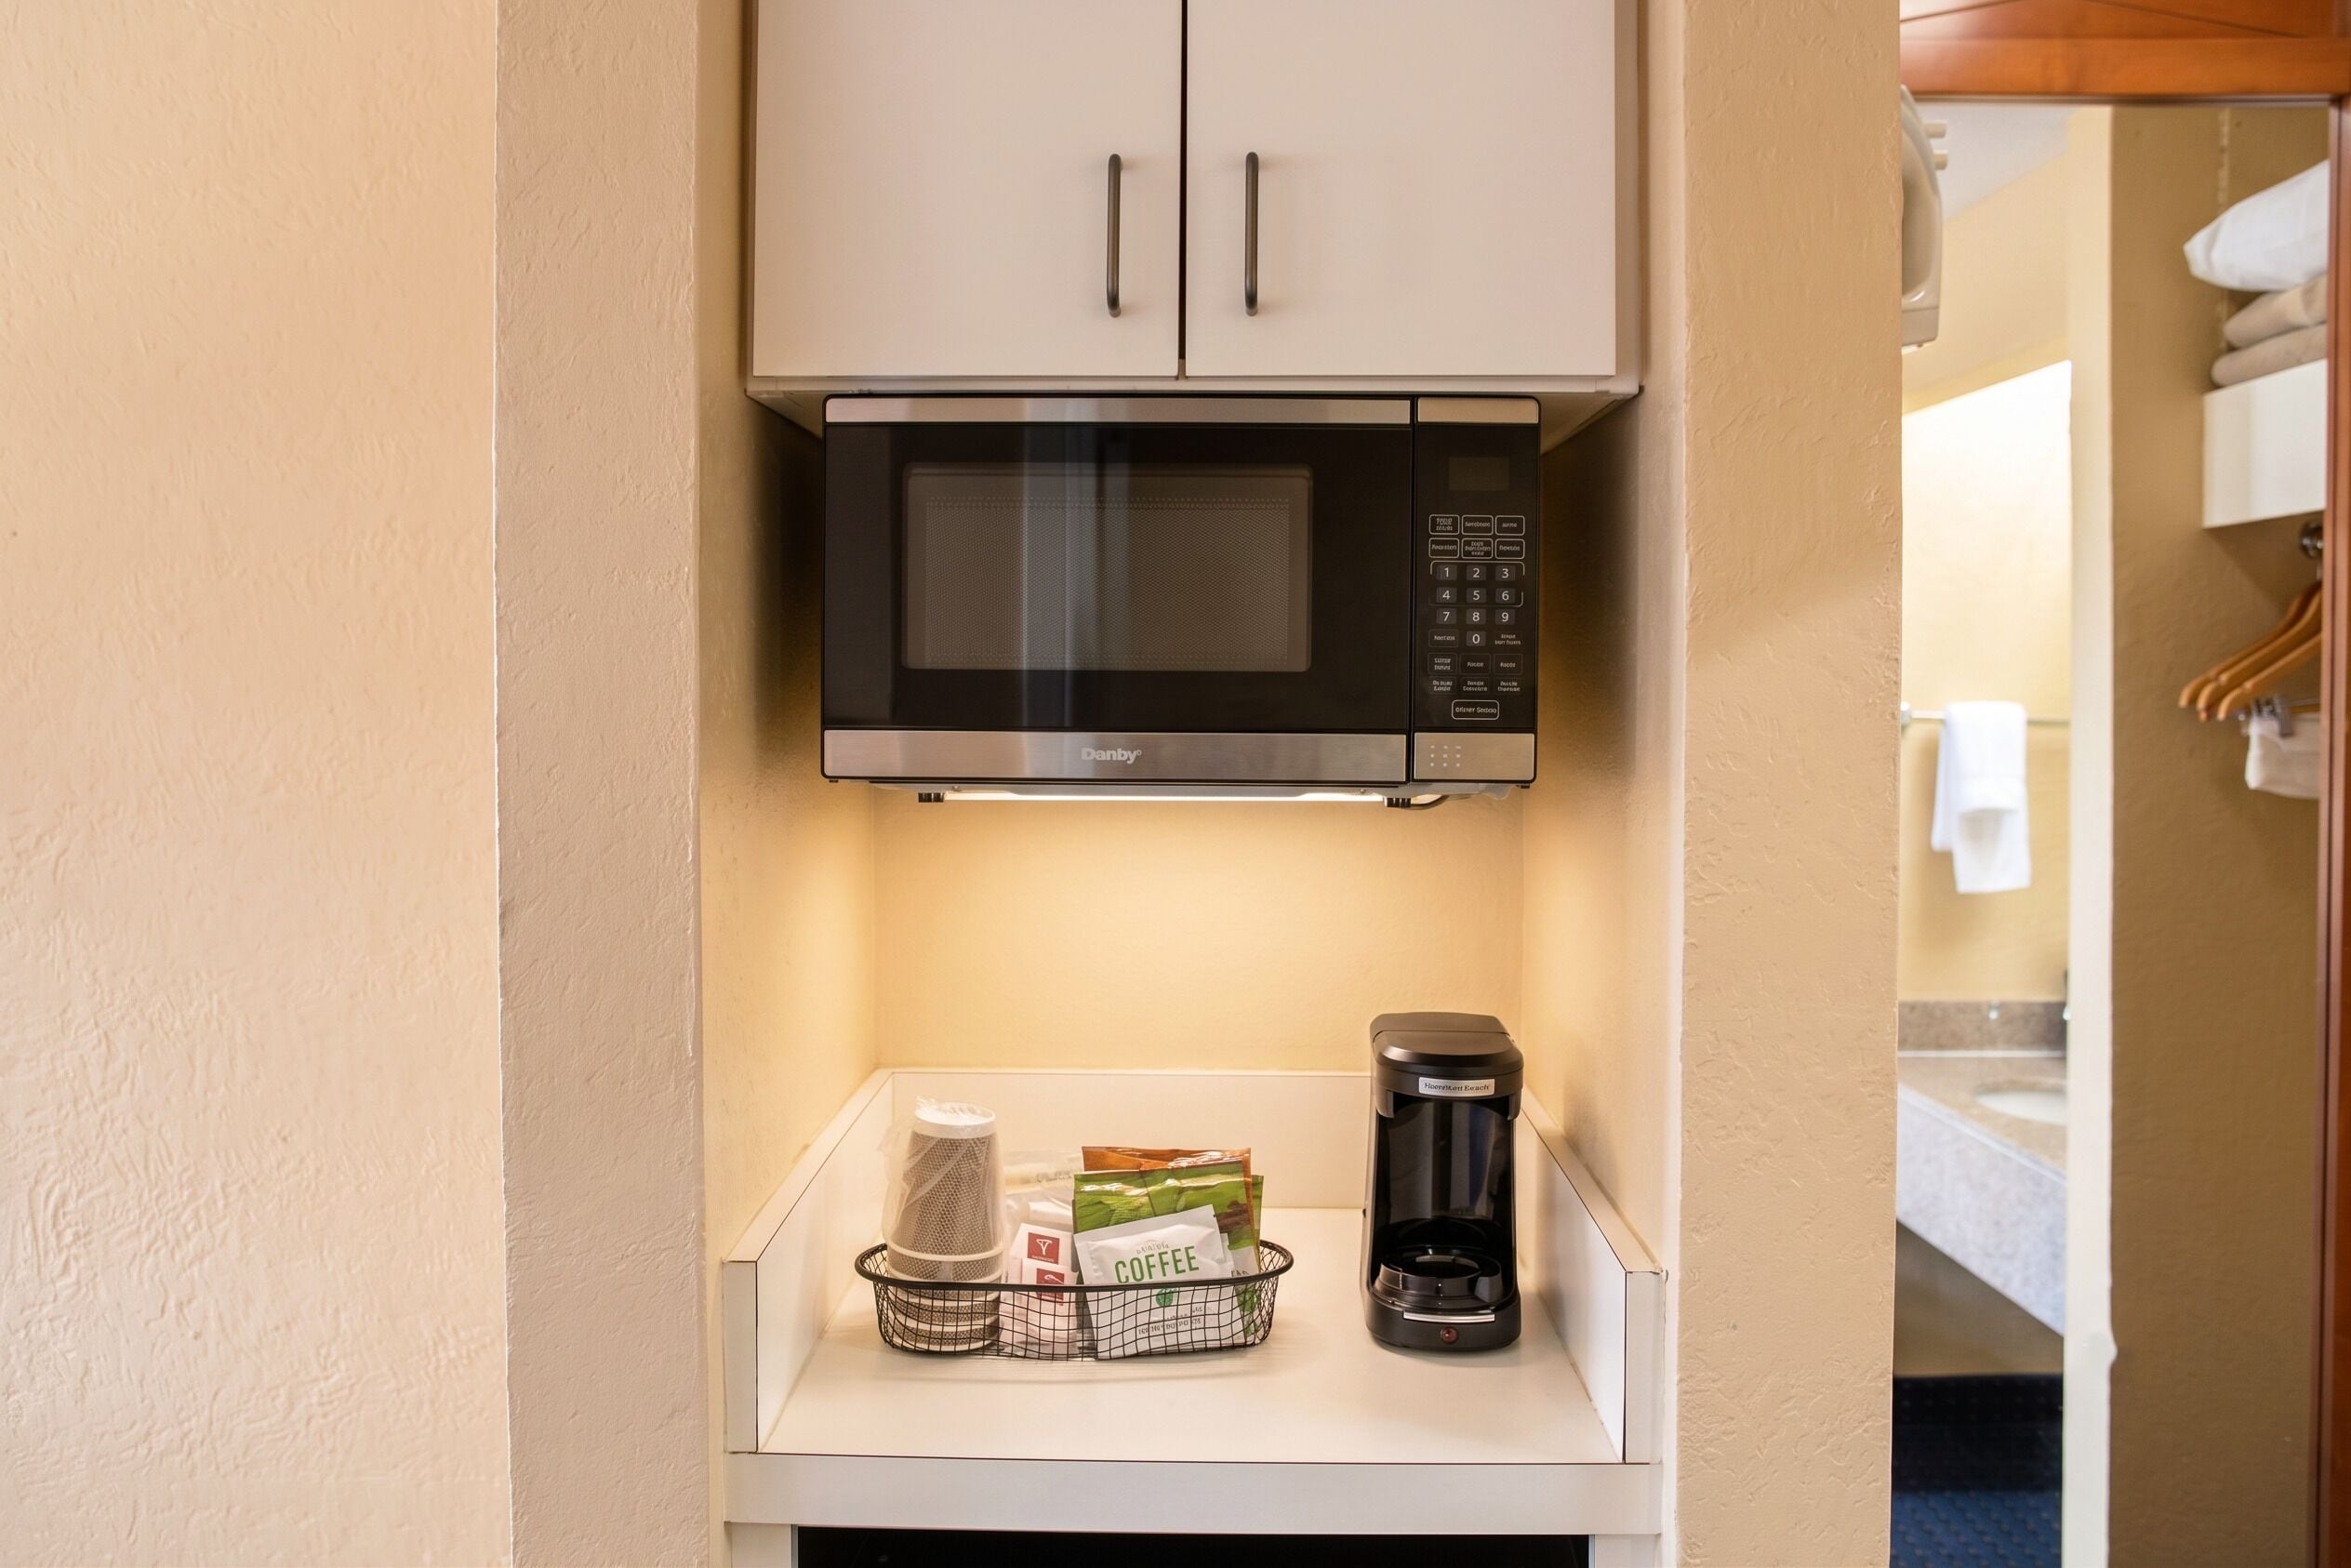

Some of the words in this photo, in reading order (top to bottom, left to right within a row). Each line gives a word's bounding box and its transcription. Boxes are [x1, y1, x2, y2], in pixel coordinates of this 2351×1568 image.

[1443, 566, 1449, 578] 1
[1472, 567, 1481, 578] 2
[1502, 568, 1509, 578] 3
[1442, 590, 1451, 600] 4
[1472, 590, 1481, 601] 5
[1501, 591, 1509, 601] 6
[1442, 611, 1451, 622] 7
[1472, 612, 1481, 622] 8
[1501, 612, 1509, 622] 9
[1472, 633, 1481, 644] 0
[1115, 1246, 1200, 1283] COFFEE
